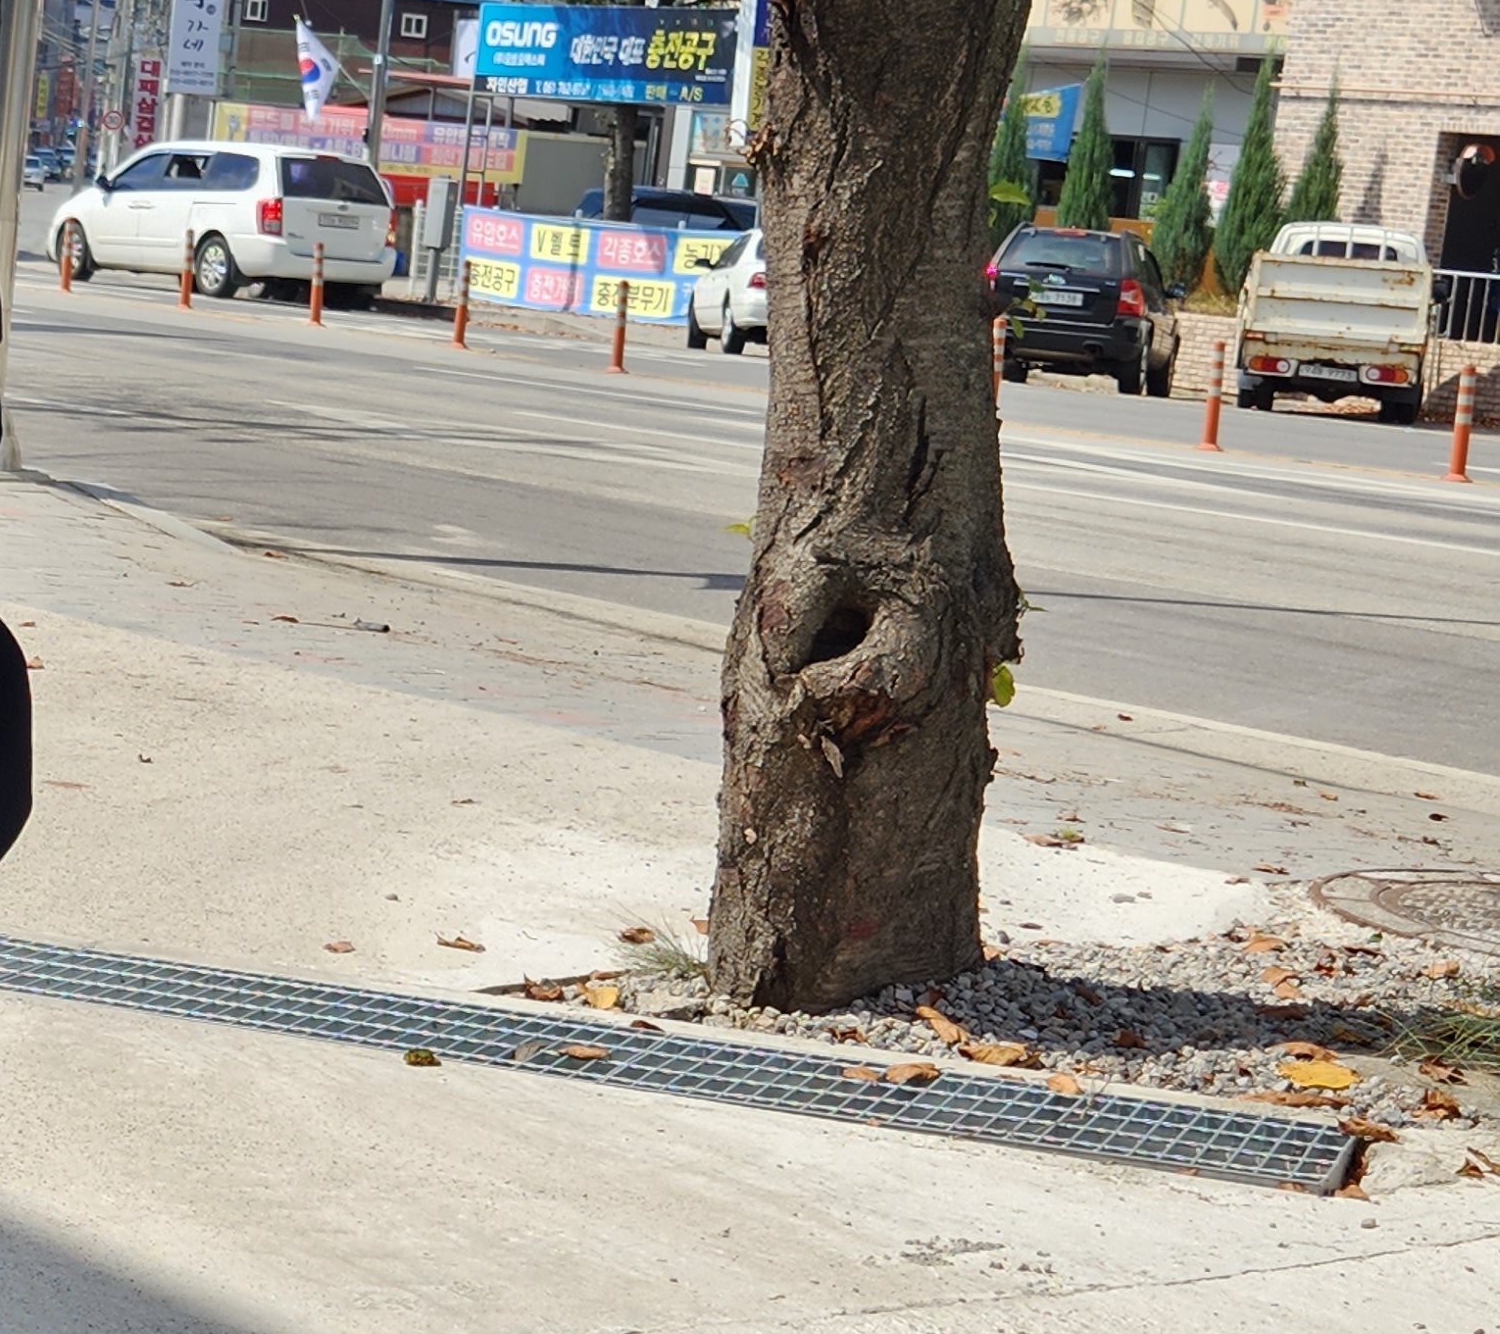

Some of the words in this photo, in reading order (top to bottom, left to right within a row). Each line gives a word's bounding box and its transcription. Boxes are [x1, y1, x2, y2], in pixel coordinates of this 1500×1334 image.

[485, 20, 557, 47] OSUNG
[570, 34, 617, 66] 대한민국
[645, 29, 716, 71] 충전공구
[678, 84, 702, 101] A/S
[471, 221, 518, 249] 유압호스
[603, 240, 662, 267] 각종호스
